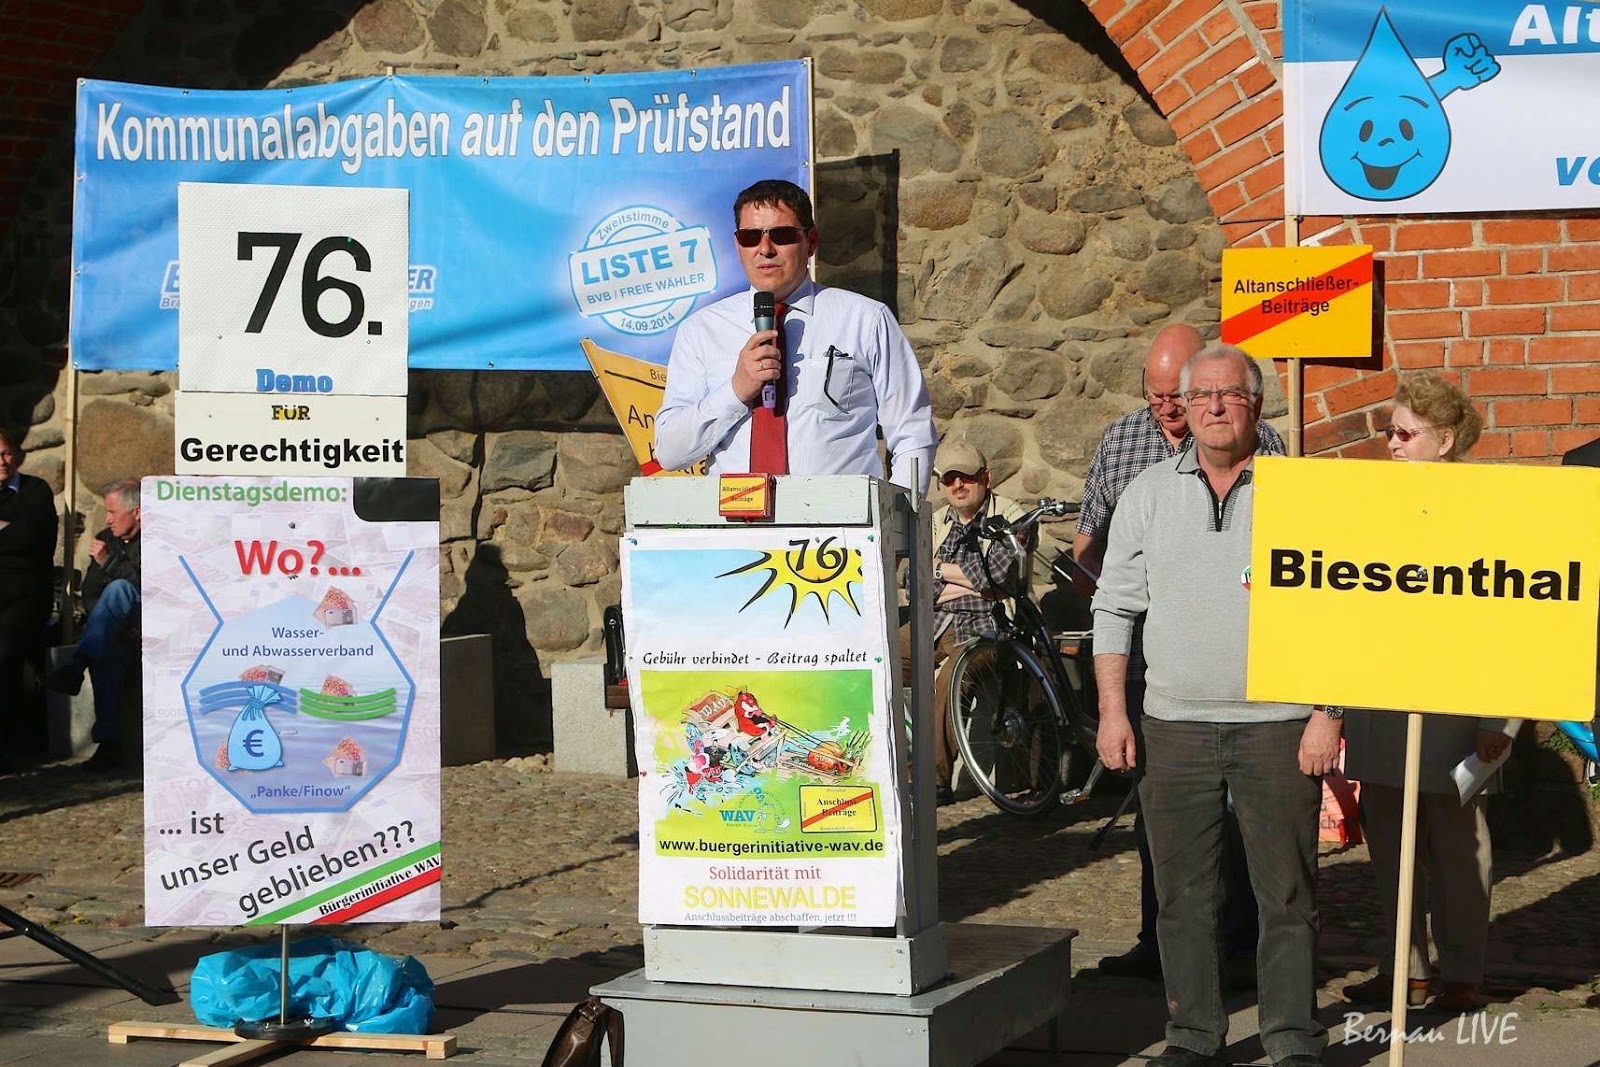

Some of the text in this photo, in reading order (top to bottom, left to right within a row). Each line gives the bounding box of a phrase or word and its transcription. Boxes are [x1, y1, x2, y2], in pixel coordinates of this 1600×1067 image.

[97, 85, 791, 174] Kommunalabgaben auf den Prüfstand
[596, 211, 670, 240] Zweitstimme
[581, 239, 698, 285] LISTE 7
[237, 232, 382, 337] 76.
[587, 291, 612, 304] BVB
[620, 283, 654, 298] FREIE
[655, 272, 706, 290] WÄHLER
[1234, 275, 1359, 294] Altanschließer-
[1261, 299, 1330, 317] Beiträge
[620, 313, 676, 331] 14.09.2014
[256, 368, 333, 393] Demo
[271, 404, 311, 421] FÜR
[180, 437, 404, 468] Gerechtigkeit
[156, 480, 347, 506] Dienstagsdemo:
[234, 540, 361, 576] Wo?...
[789, 536, 843, 571] 76
[1269, 548, 1581, 602] Biesenthal
[271, 627, 324, 639] Wasser-
[222, 645, 374, 657] und Abwasserverband
[643, 651, 687, 665] Gebühr
[692, 651, 749, 665] verbindet
[767, 652, 818, 666] Beitrag
[825, 648, 868, 665] spaltet
[191, 811, 224, 834] ist
[719, 810, 756, 821] WAV
[160, 826, 315, 890] unser Geld
[660, 838, 883, 856] www.buergerinitiative-wav.de
[239, 820, 415, 918] geblieben???
[709, 866, 821, 880] Solidarität mit
[319, 856, 440, 915] Bürgerinitiative WAV
[684, 885, 857, 909] SONNEWALDE
[685, 912, 767, 923] Anschlussbeiträge
[769, 912, 823, 923] abschaffen,
[825, 912, 845, 923] jetzt
